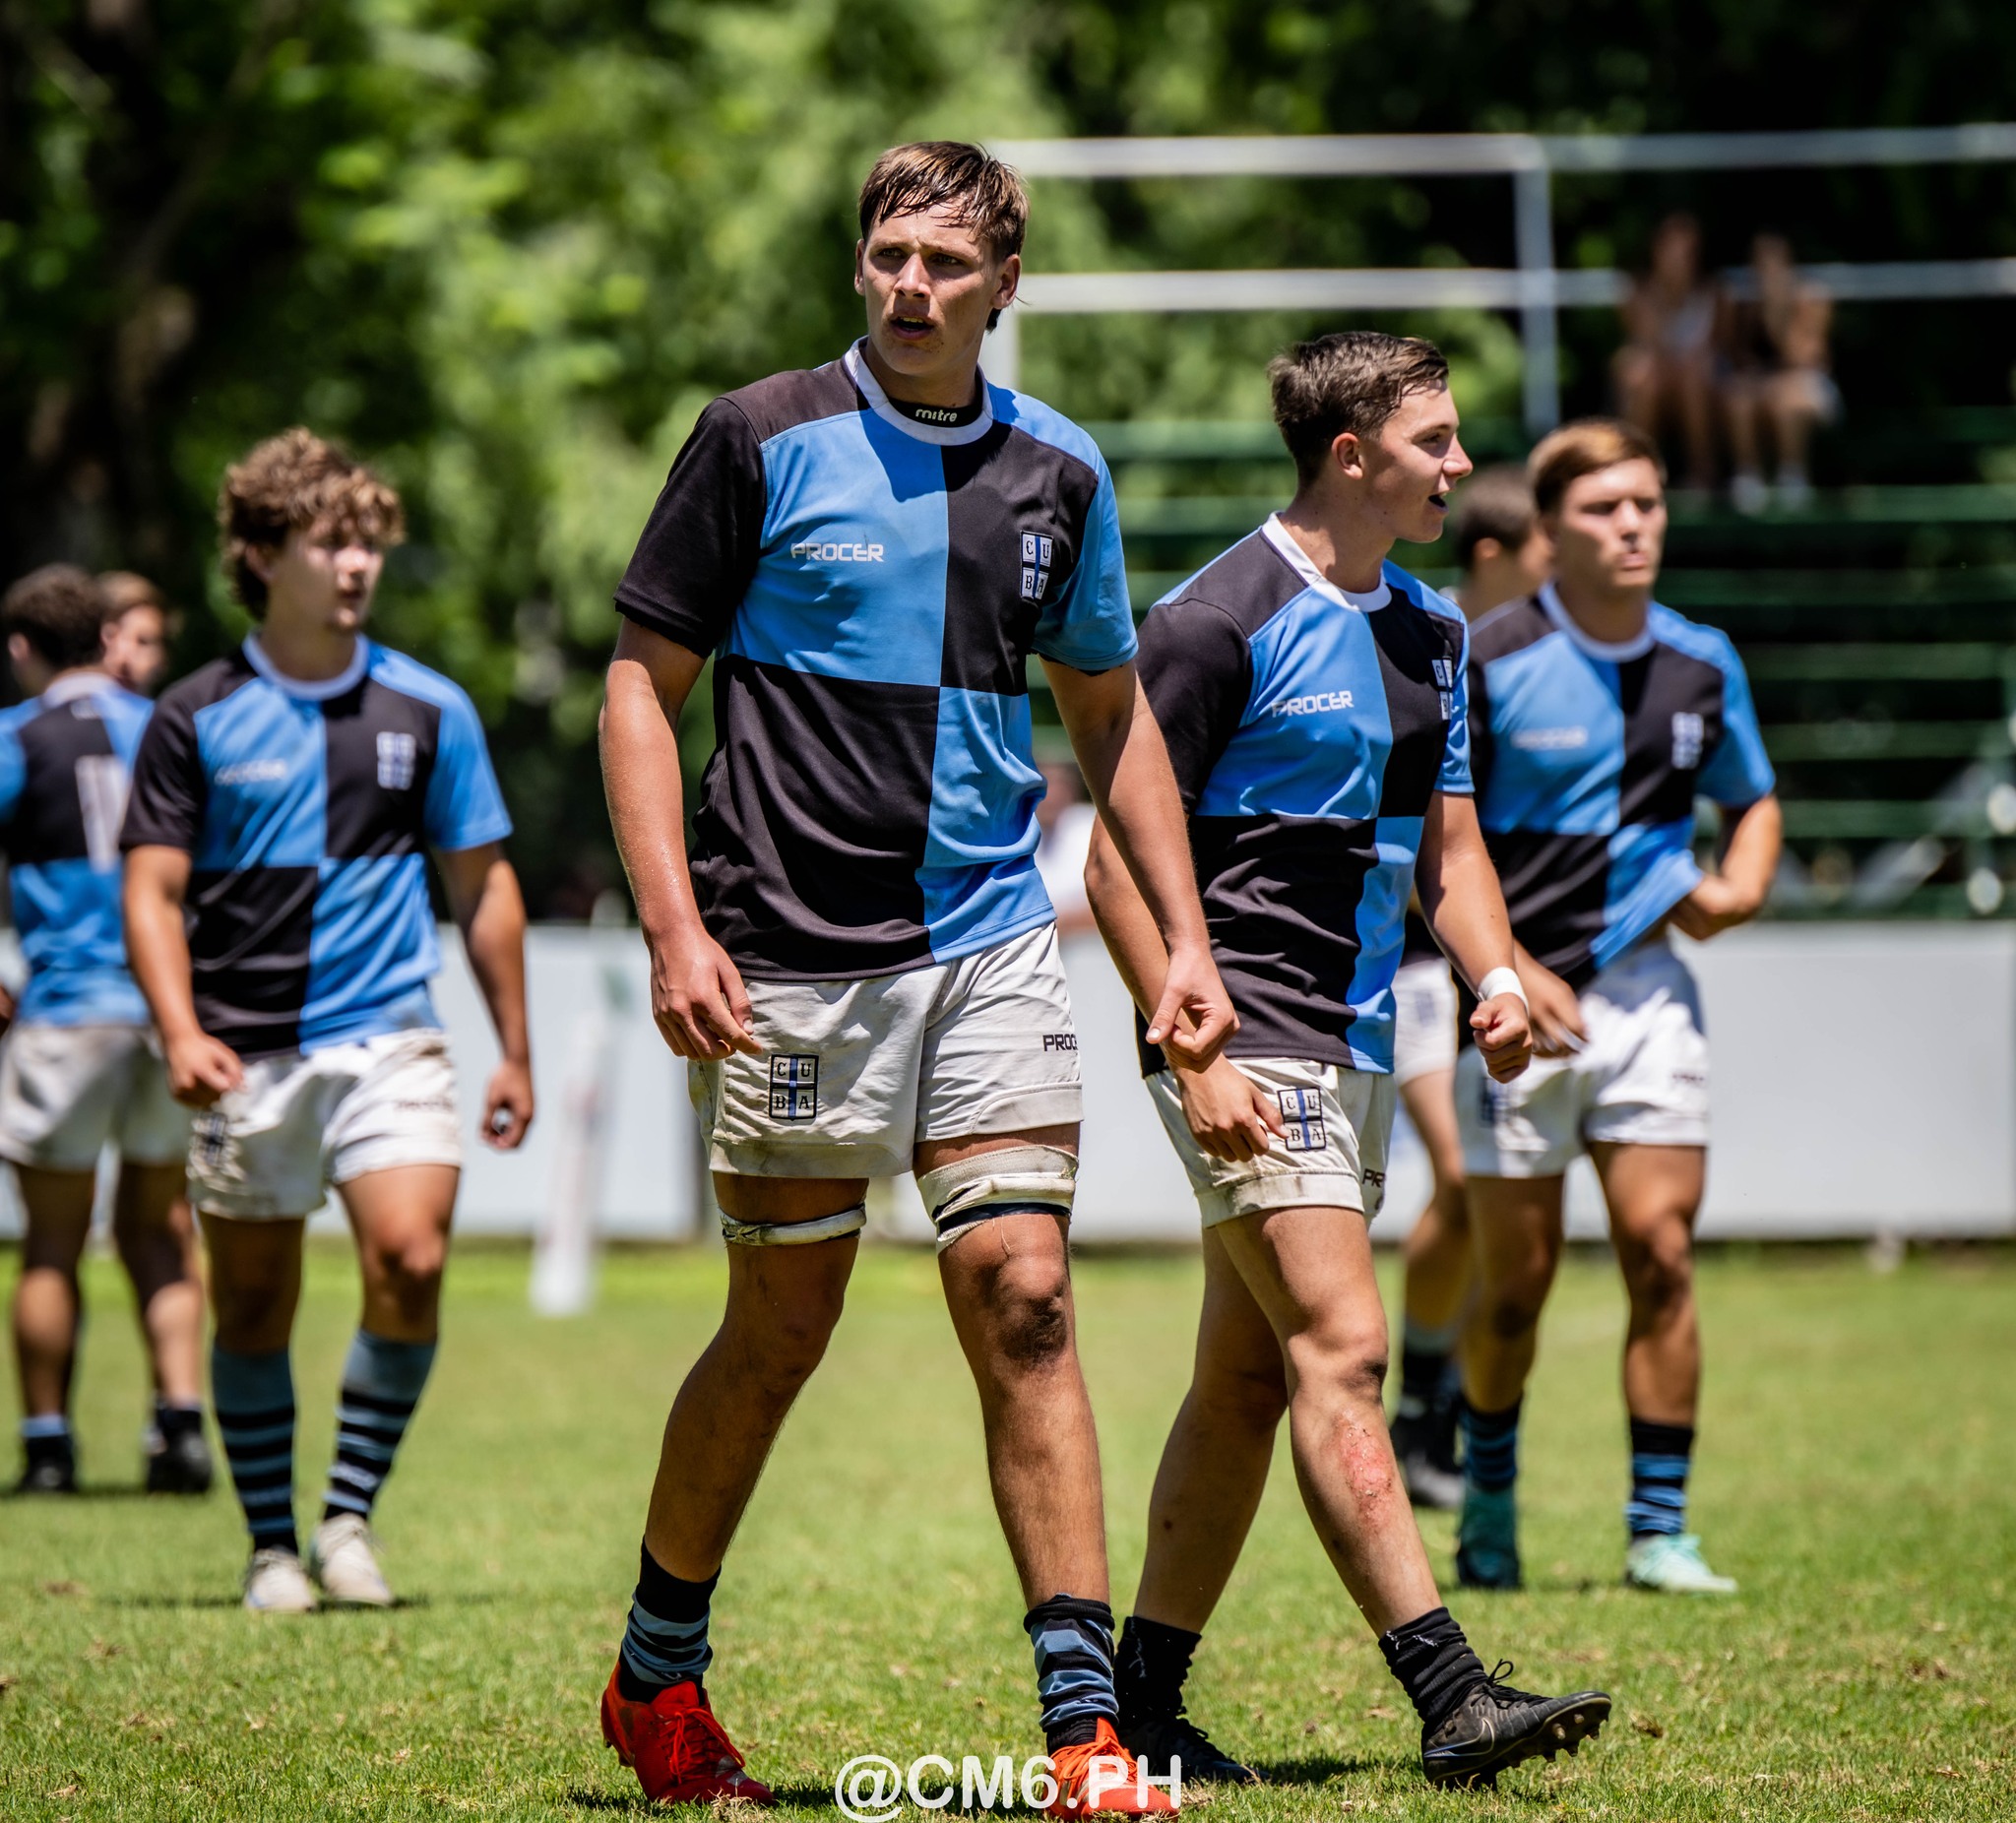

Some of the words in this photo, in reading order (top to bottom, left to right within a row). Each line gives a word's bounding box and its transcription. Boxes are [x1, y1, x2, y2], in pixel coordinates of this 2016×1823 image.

[915, 409, 957, 422] mitre
[790, 542, 884, 562] PROCER
[1271, 690, 1354, 718] PROCER
[1042, 1034, 1078, 1052] PROC
[1362, 1167, 1386, 1187] PR
